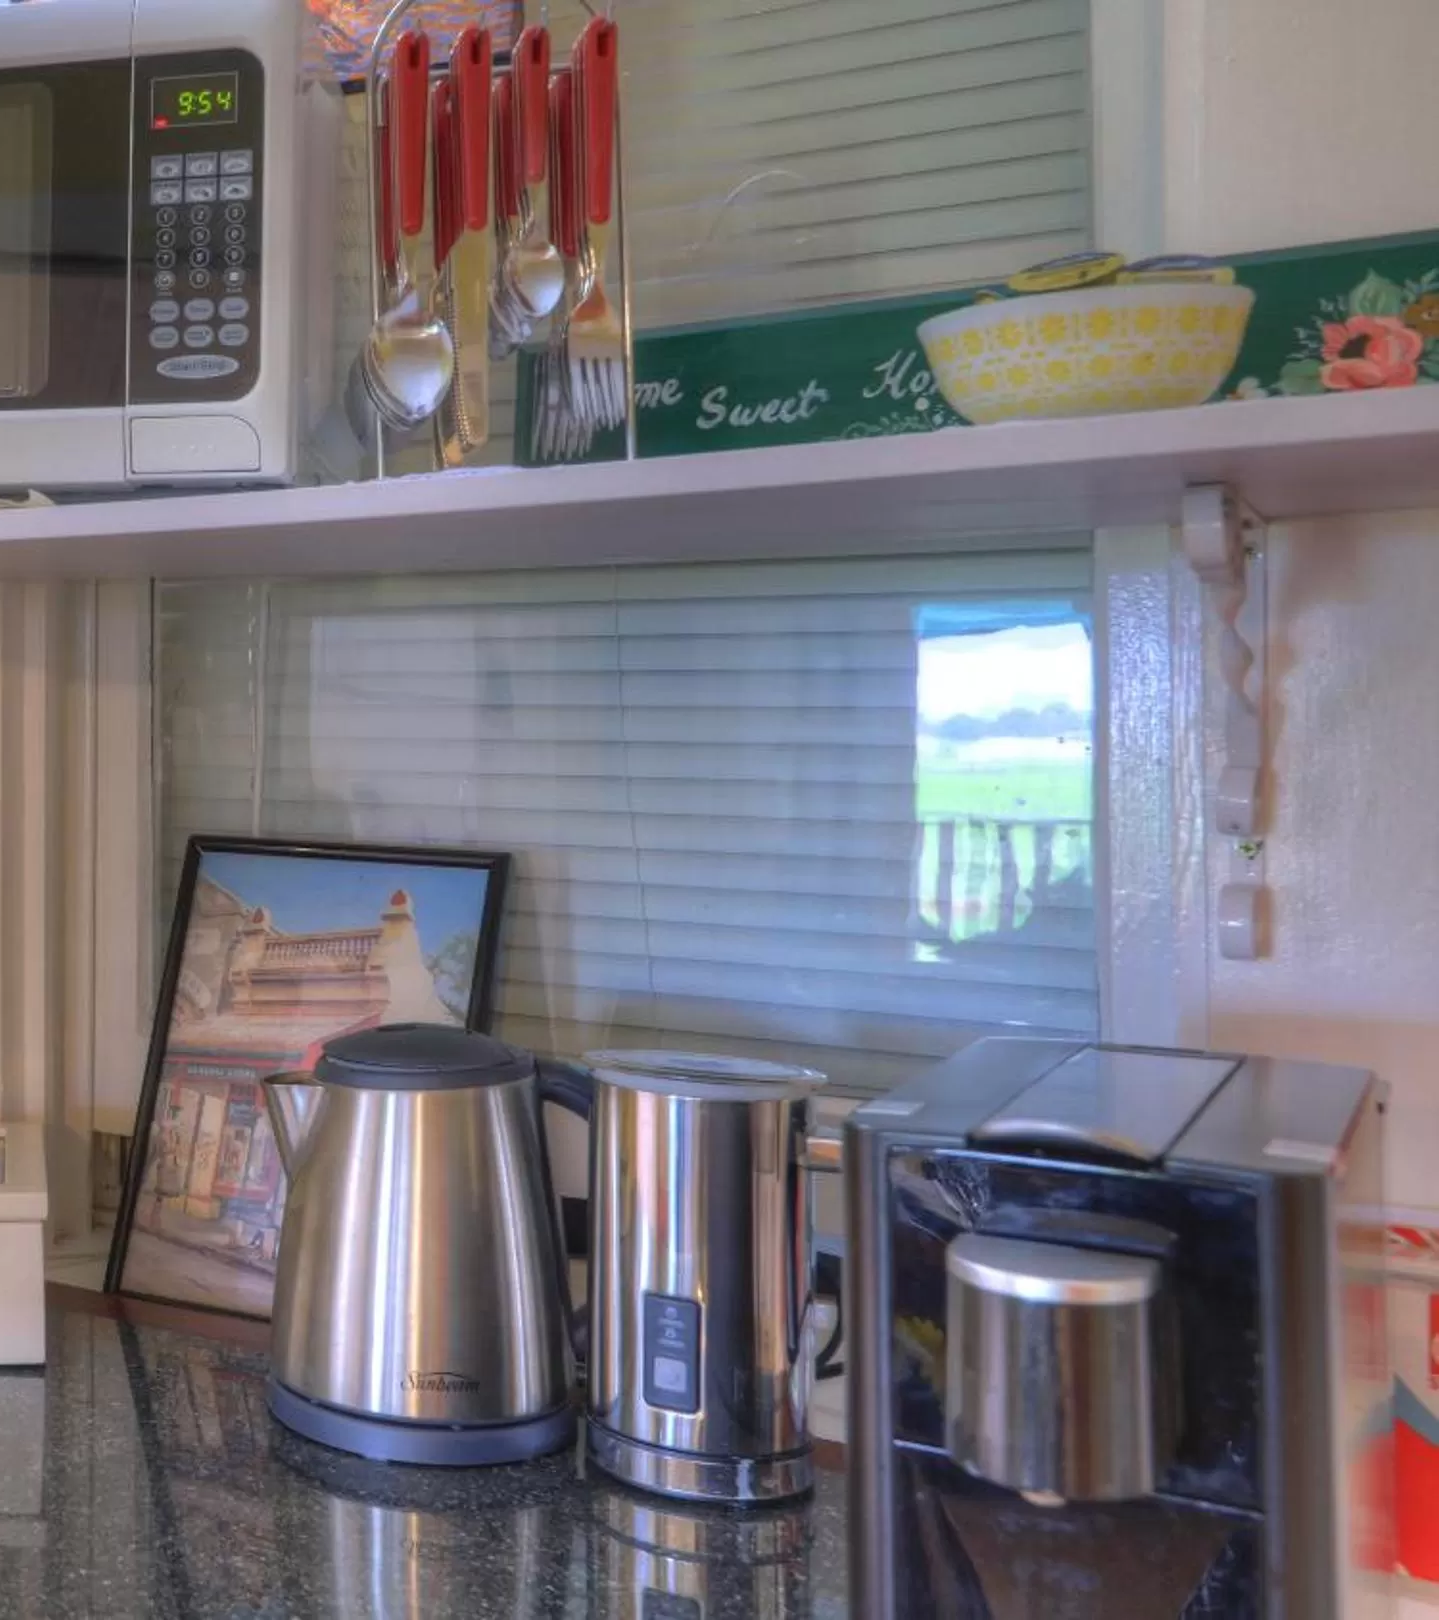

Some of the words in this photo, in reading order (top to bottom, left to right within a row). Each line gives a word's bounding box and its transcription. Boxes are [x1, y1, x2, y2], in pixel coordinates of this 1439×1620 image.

[633, 377, 683, 408] me
[695, 378, 830, 430] Sweet
[863, 349, 942, 400] Ho
[400, 1371, 481, 1396] Sunbeam
